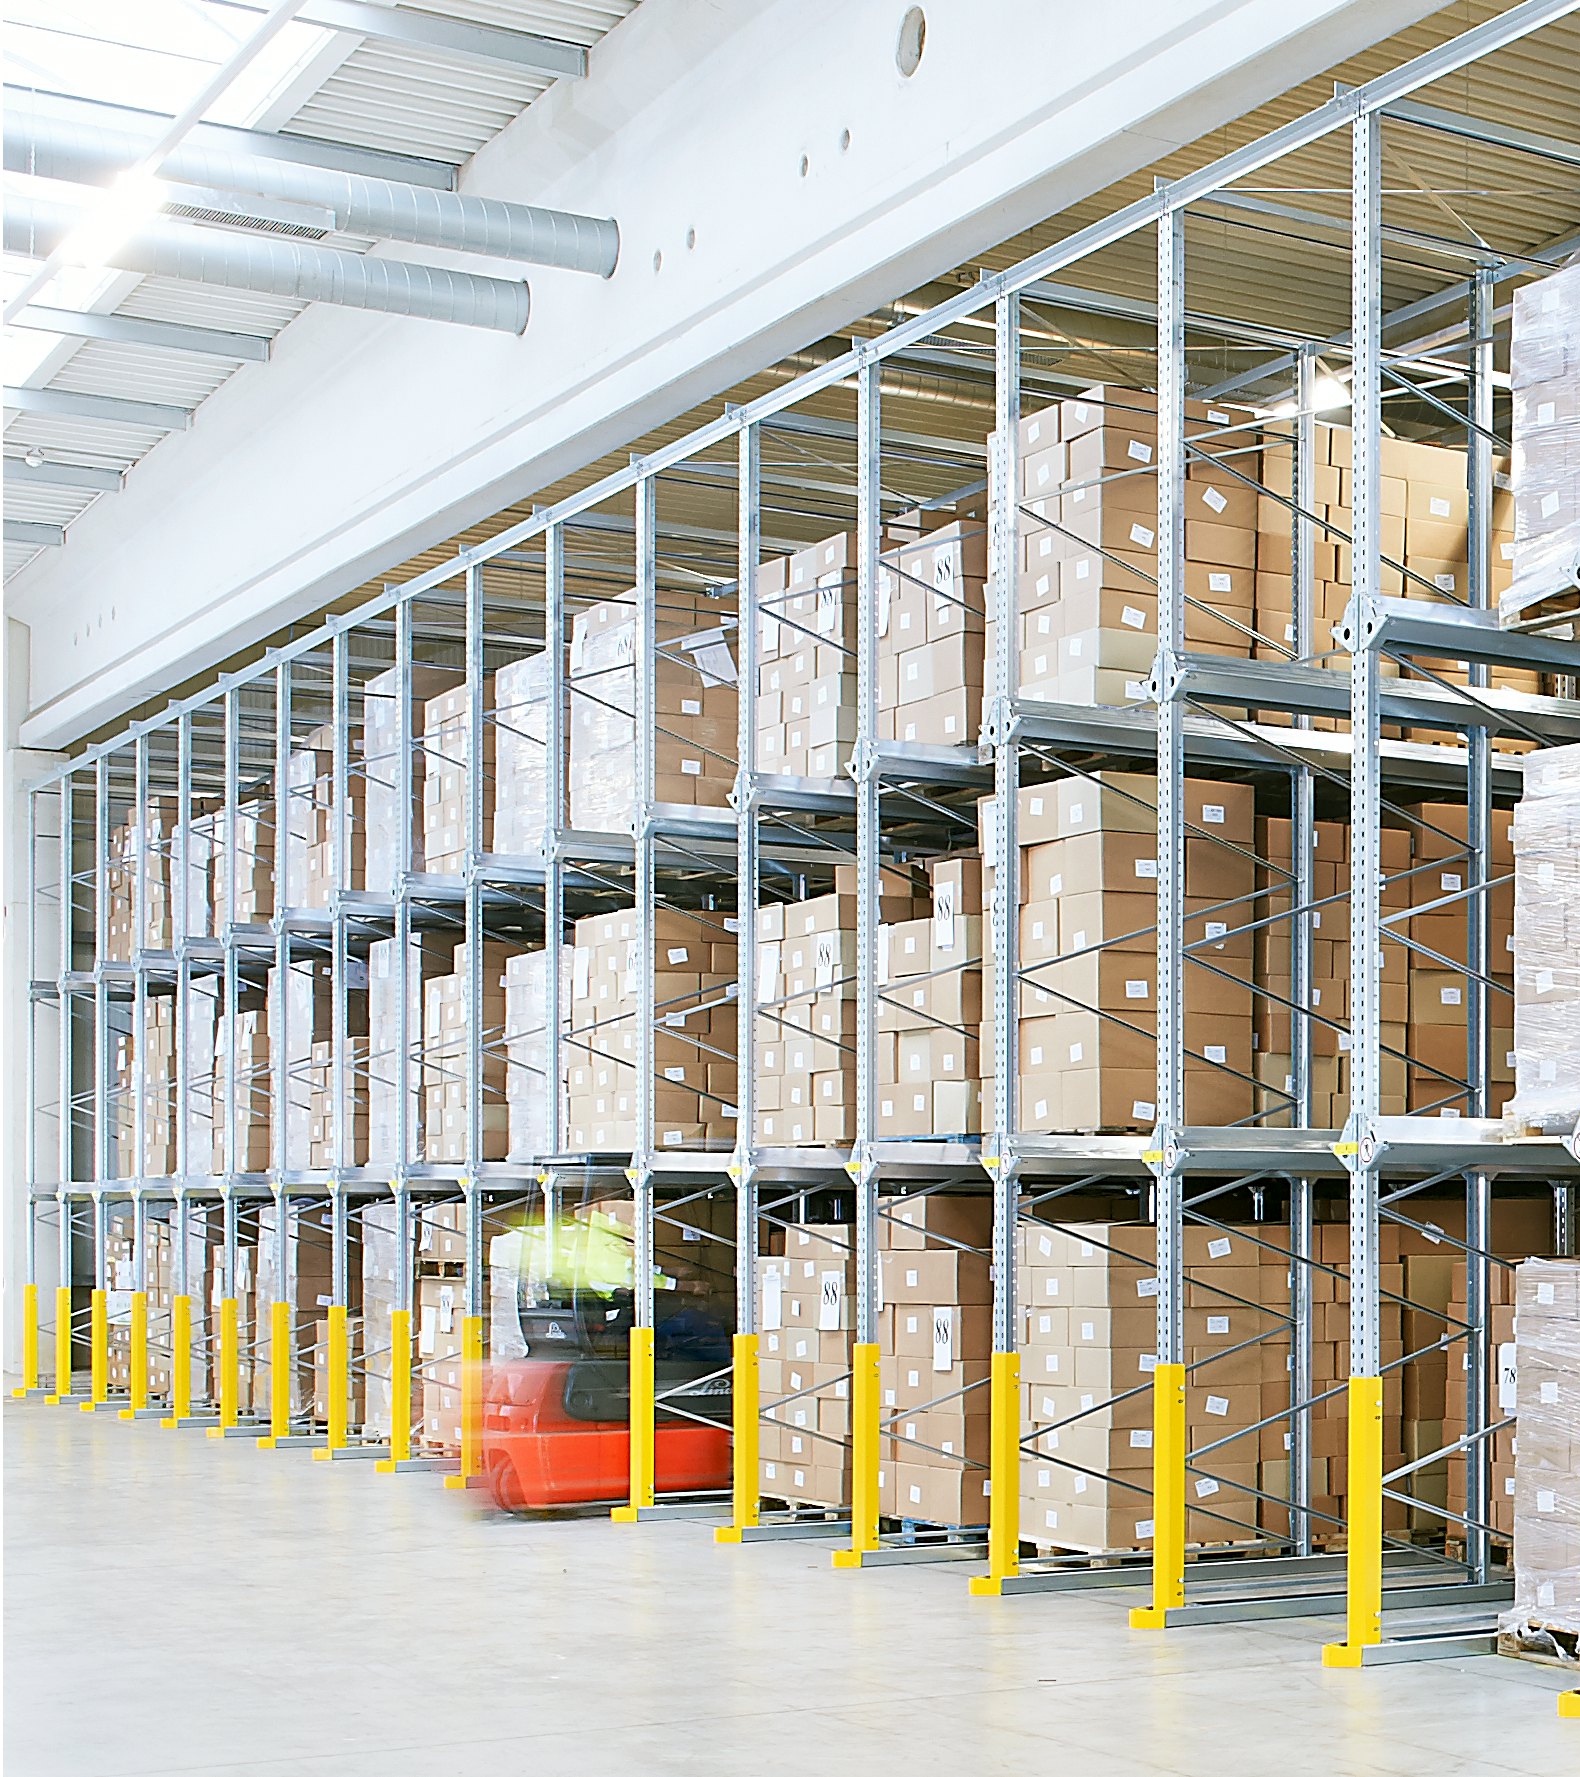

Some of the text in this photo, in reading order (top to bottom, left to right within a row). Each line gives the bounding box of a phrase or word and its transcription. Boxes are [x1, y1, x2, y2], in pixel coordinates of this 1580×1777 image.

[936, 554, 951, 584] 88
[937, 894, 951, 922] 88
[817, 942, 832, 968] 88
[823, 1281, 838, 1305] 88
[935, 1318, 950, 1344] 88
